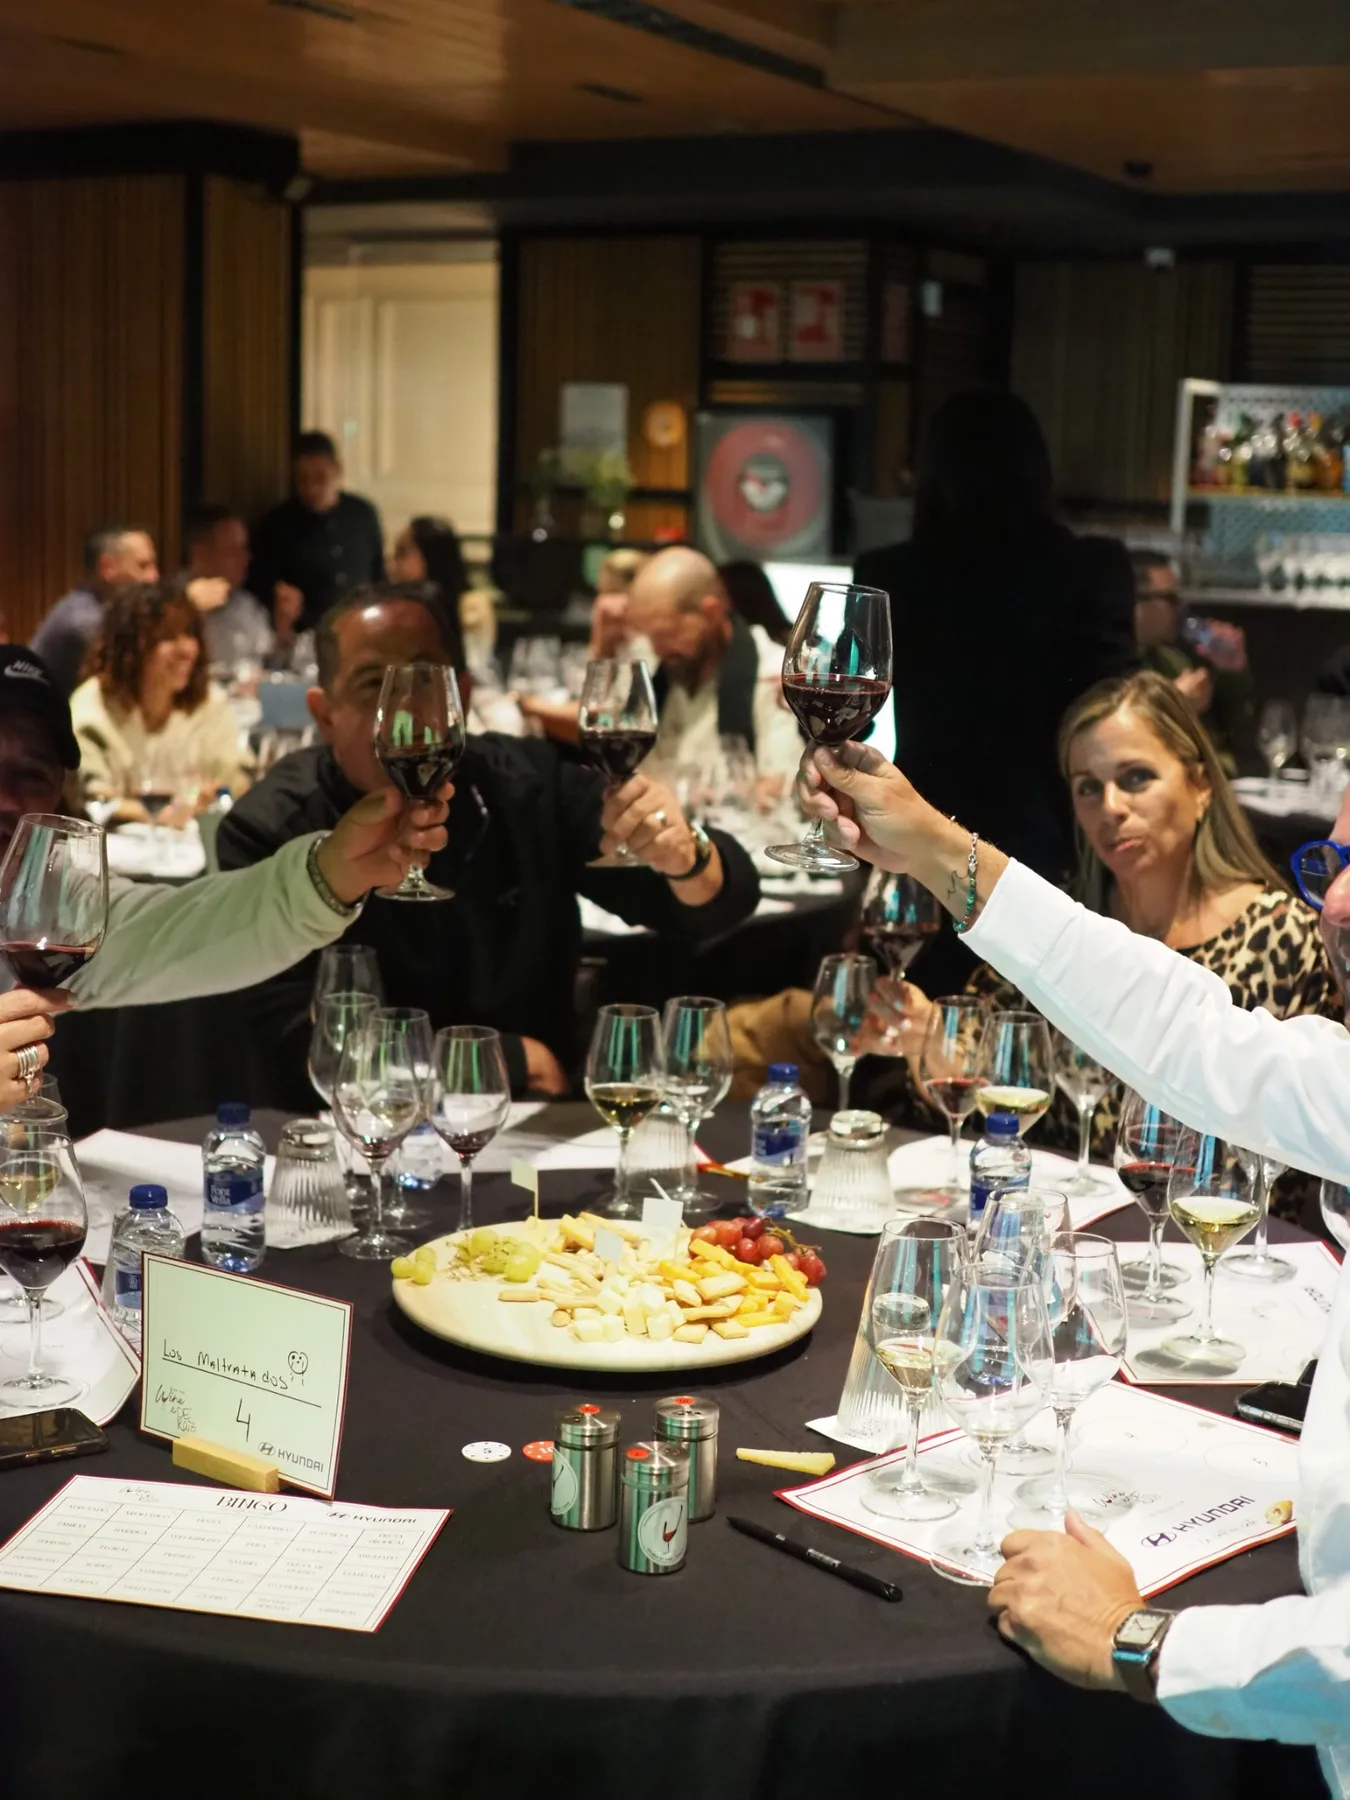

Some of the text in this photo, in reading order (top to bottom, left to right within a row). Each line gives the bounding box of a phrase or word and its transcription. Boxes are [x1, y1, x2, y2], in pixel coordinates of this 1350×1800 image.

[163, 1338, 182, 1361] Los
[236, 1398, 251, 1442] 4
[277, 1448, 324, 1473] HYUNDAI
[215, 1495, 288, 1513] BINGO
[1172, 1494, 1256, 1533] HYUNDAI
[353, 1514, 417, 1524] HYUNDAI
